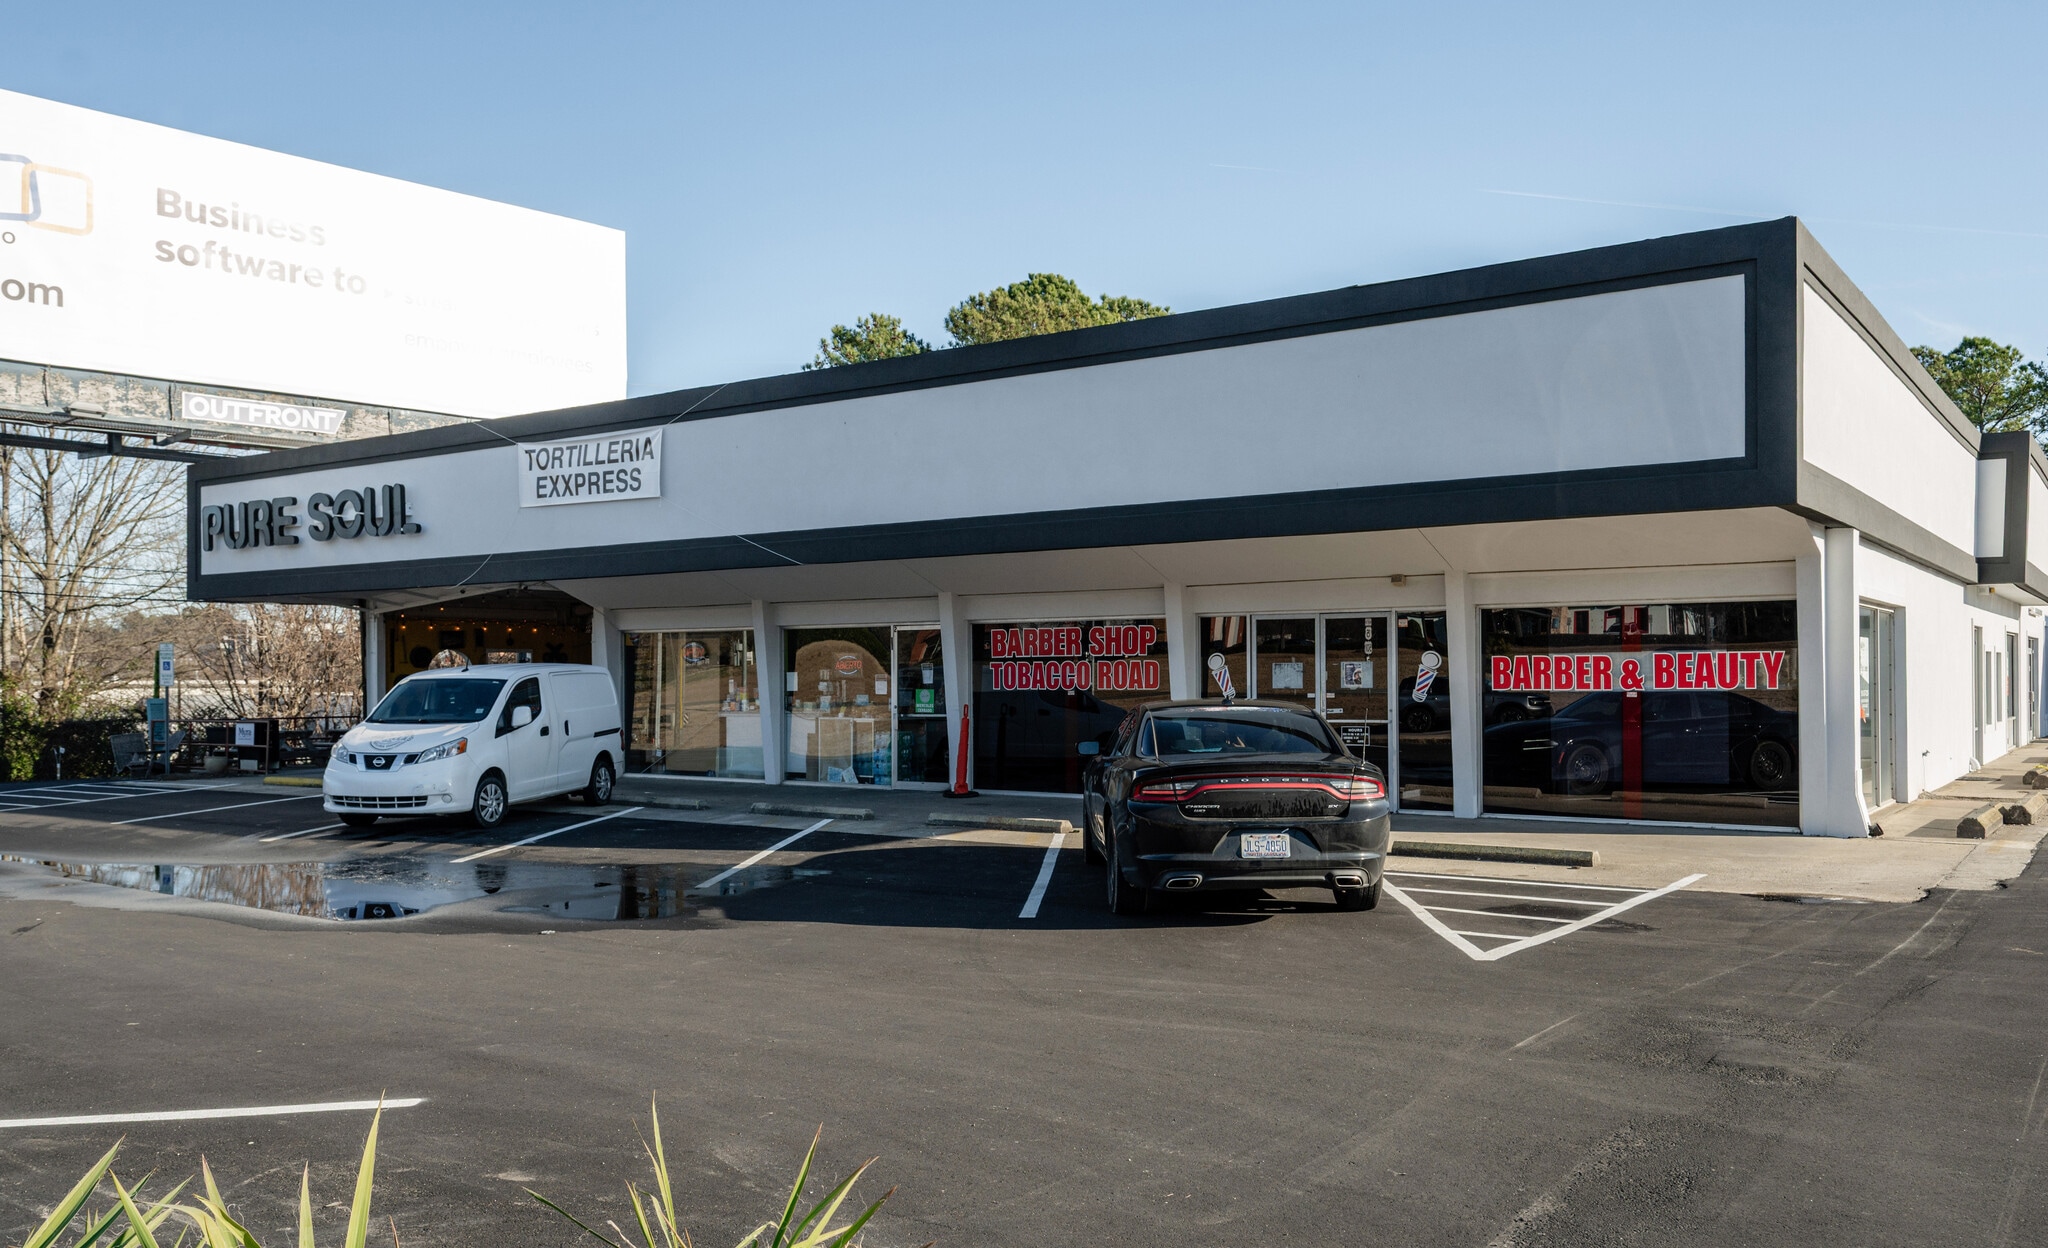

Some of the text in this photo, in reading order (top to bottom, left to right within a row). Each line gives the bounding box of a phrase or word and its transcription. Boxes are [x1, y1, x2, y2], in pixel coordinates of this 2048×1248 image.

[156, 187, 327, 246] Business
[155, 239, 367, 295] software to
[188, 396, 337, 432] OUTFRONT
[525, 436, 655, 471] TORTILLERIA
[536, 467, 642, 498] EXXPRESS
[202, 483, 422, 552] PURE SOUL
[990, 624, 1157, 659] BARBER SHOP
[989, 659, 1160, 691] TOBACCO ROAD
[1491, 650, 1785, 691] BARBER & BEAUTY
[1244, 840, 1287, 852] JLS-4850
